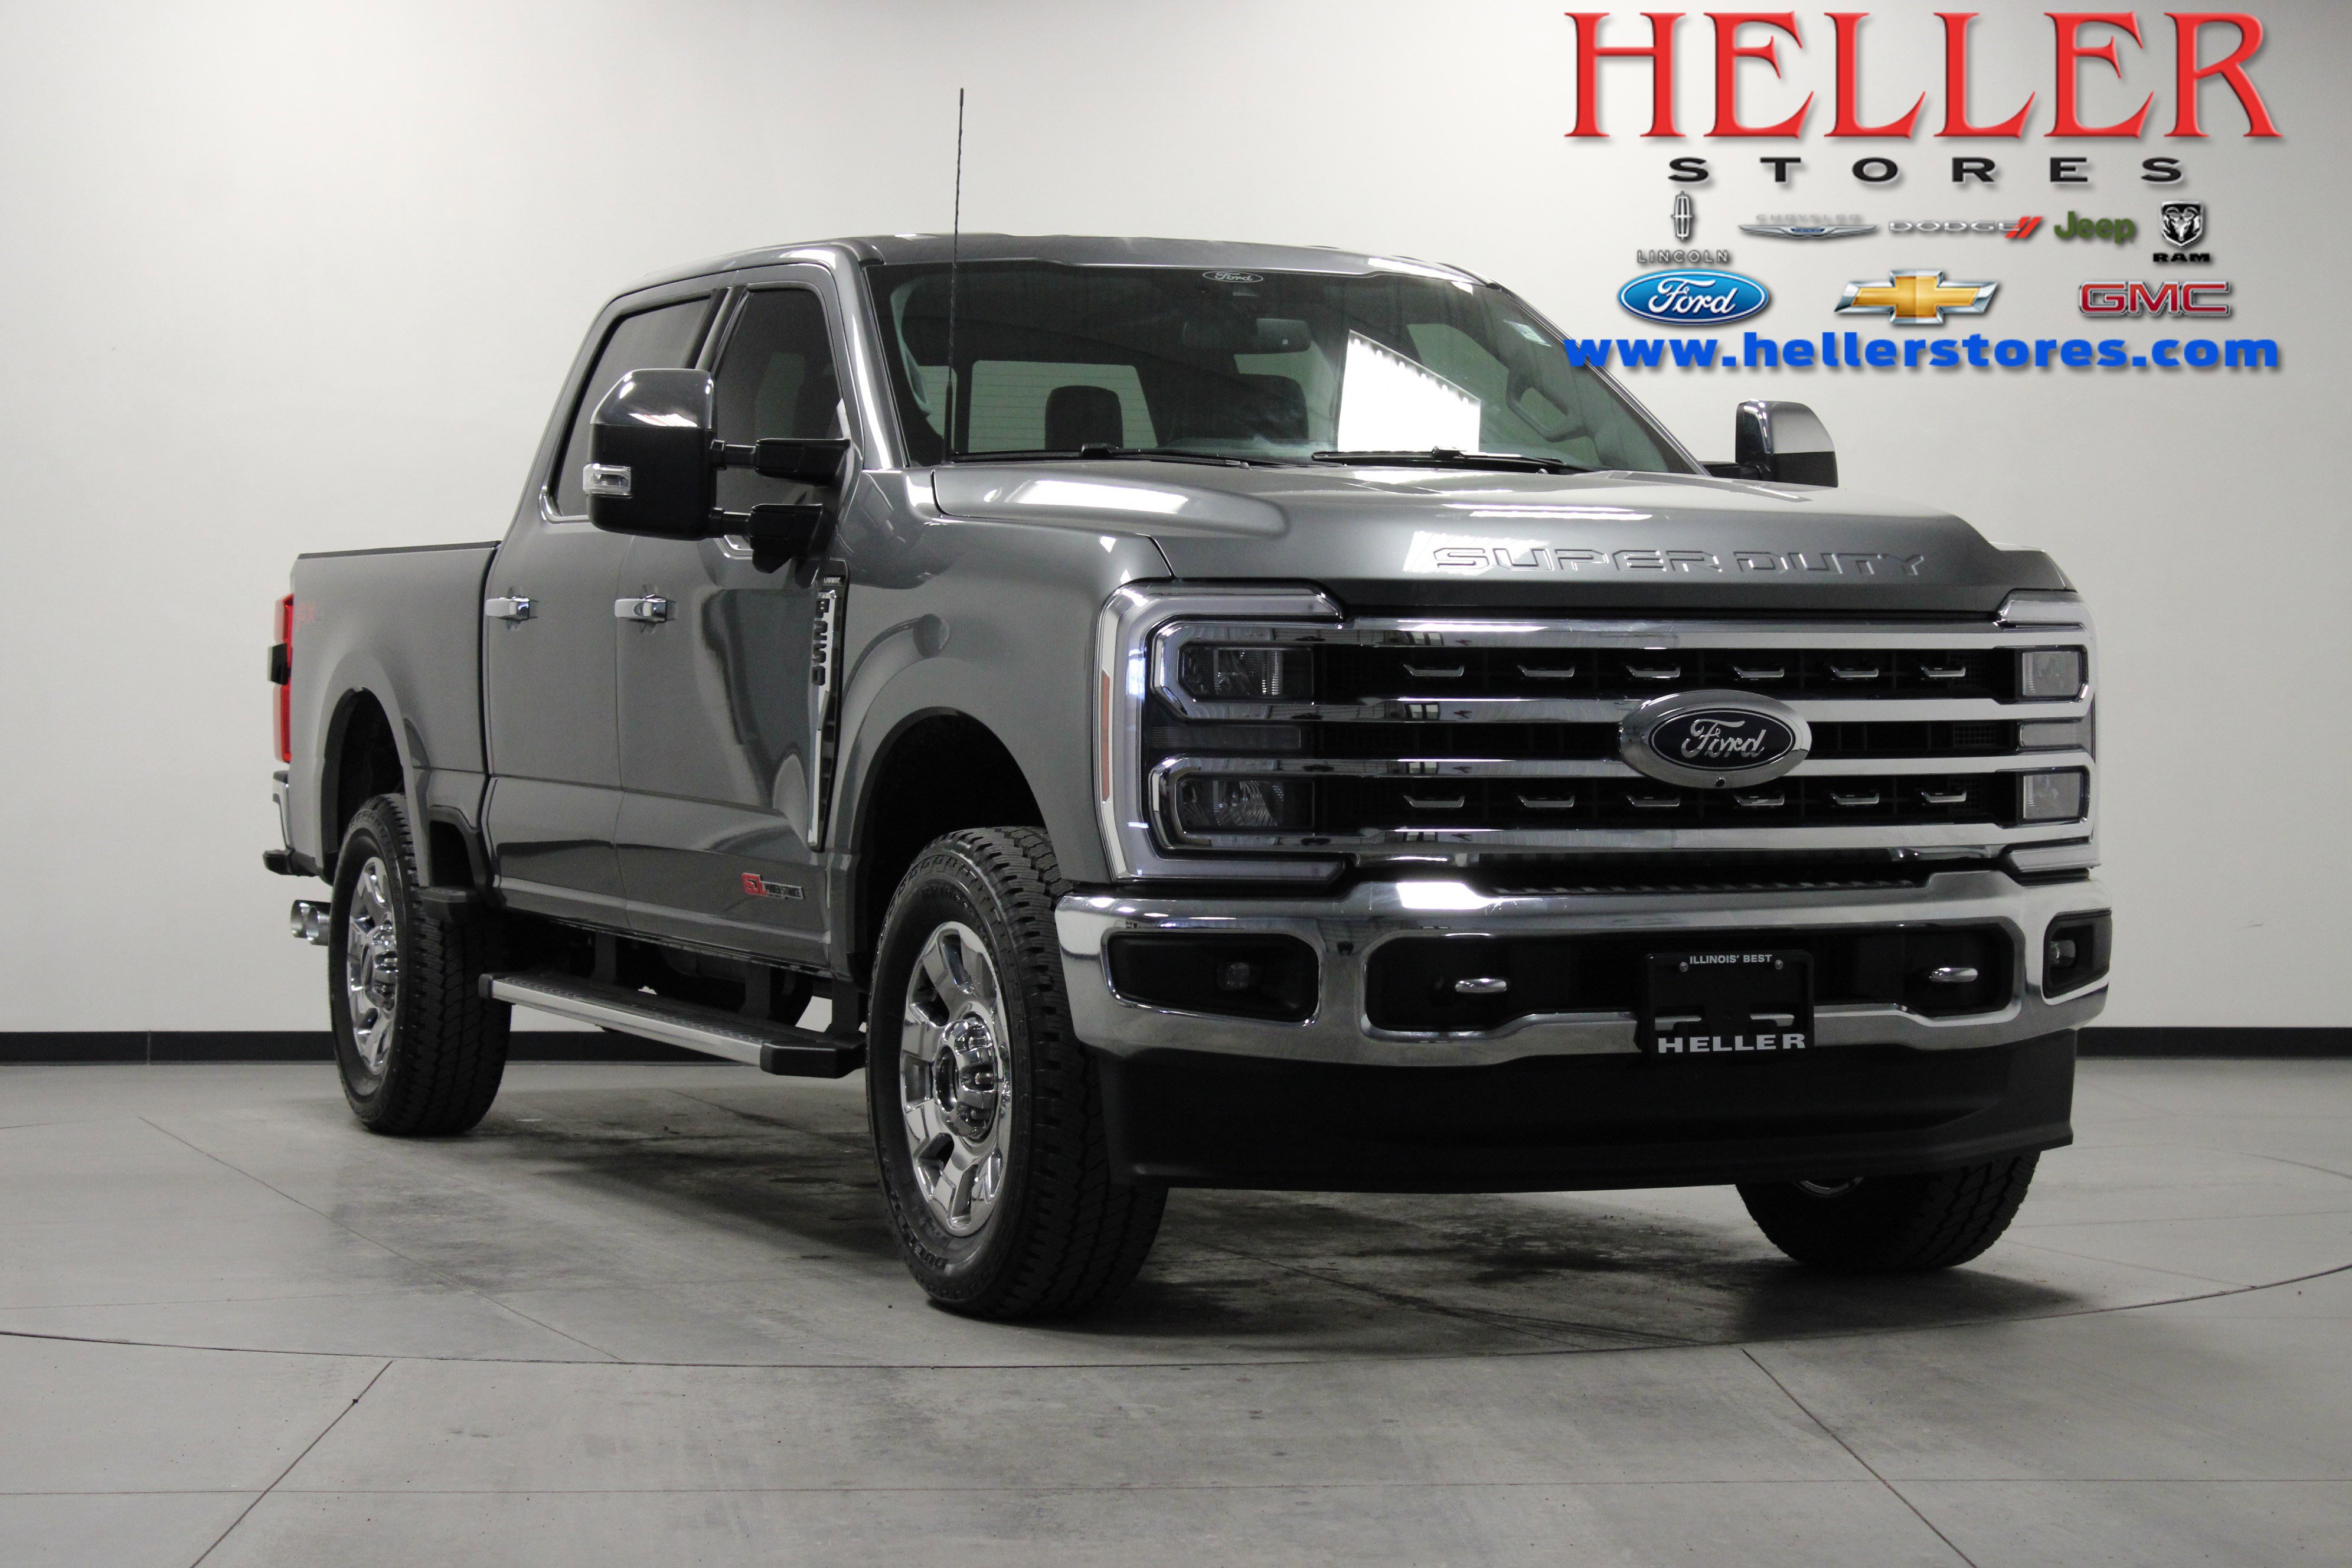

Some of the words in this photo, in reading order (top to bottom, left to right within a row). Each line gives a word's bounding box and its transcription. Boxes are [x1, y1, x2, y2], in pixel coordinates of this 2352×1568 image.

[1214, 272, 1253, 282] Ford
[1432, 547, 1724, 573] SUPER
[1733, 550, 1926, 576] DUTY
[1681, 718, 1767, 759] Ford
[1743, 953, 1773, 963] BEST
[1658, 1033, 1806, 1054] HELLER
